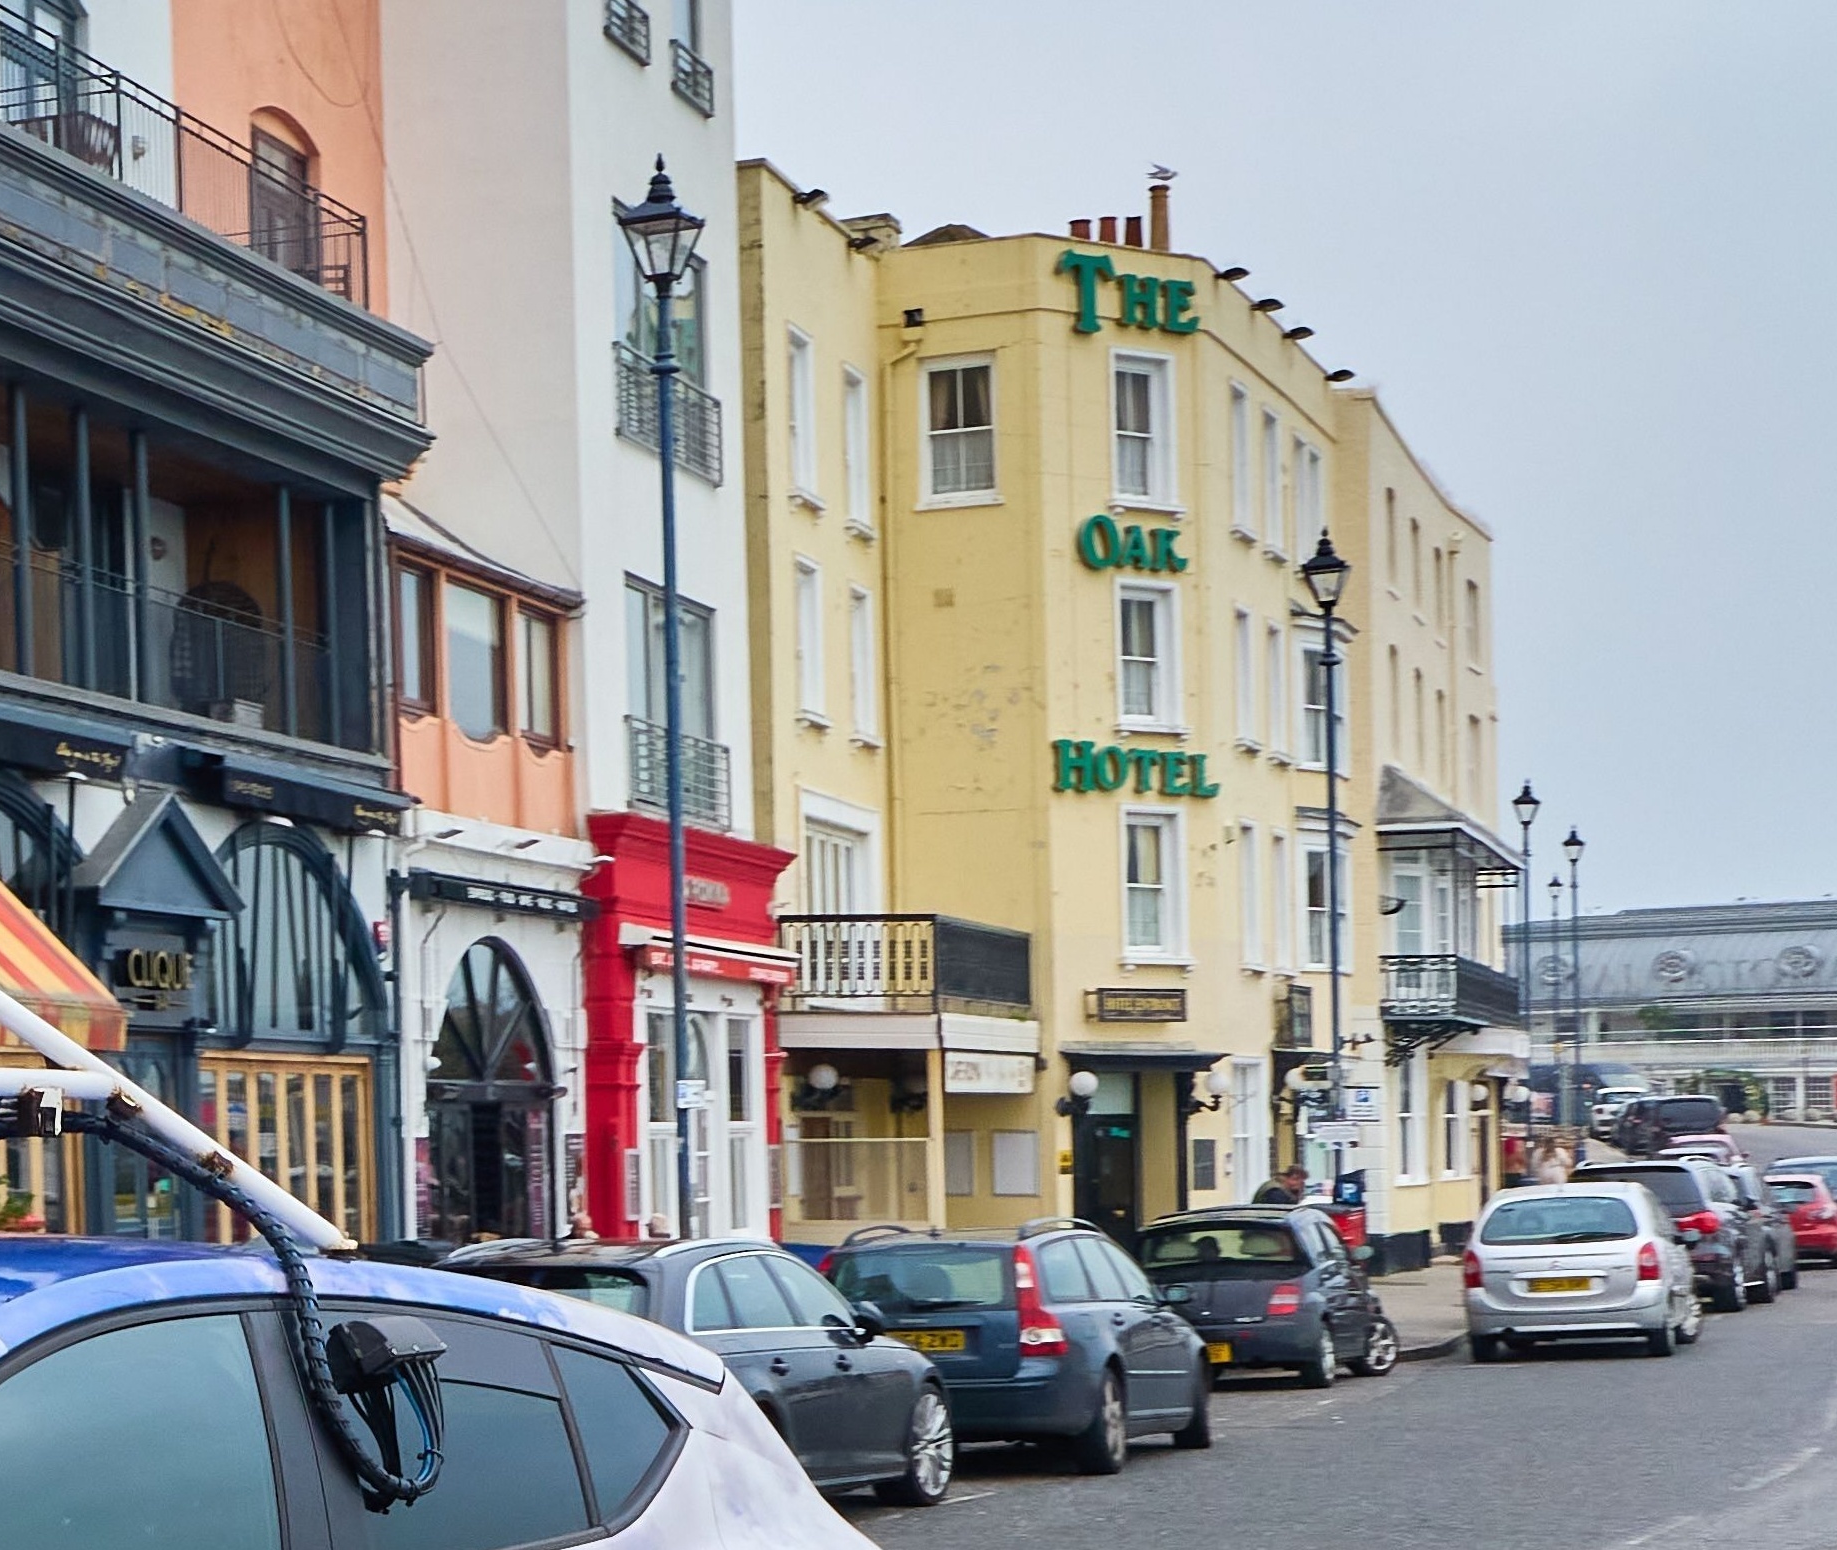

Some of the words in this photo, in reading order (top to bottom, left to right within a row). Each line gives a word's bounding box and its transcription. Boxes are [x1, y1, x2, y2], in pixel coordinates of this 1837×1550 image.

[1055, 249, 1200, 335] THE
[1077, 513, 1190, 573] OAK
[1052, 738, 1222, 799] HOTEL
